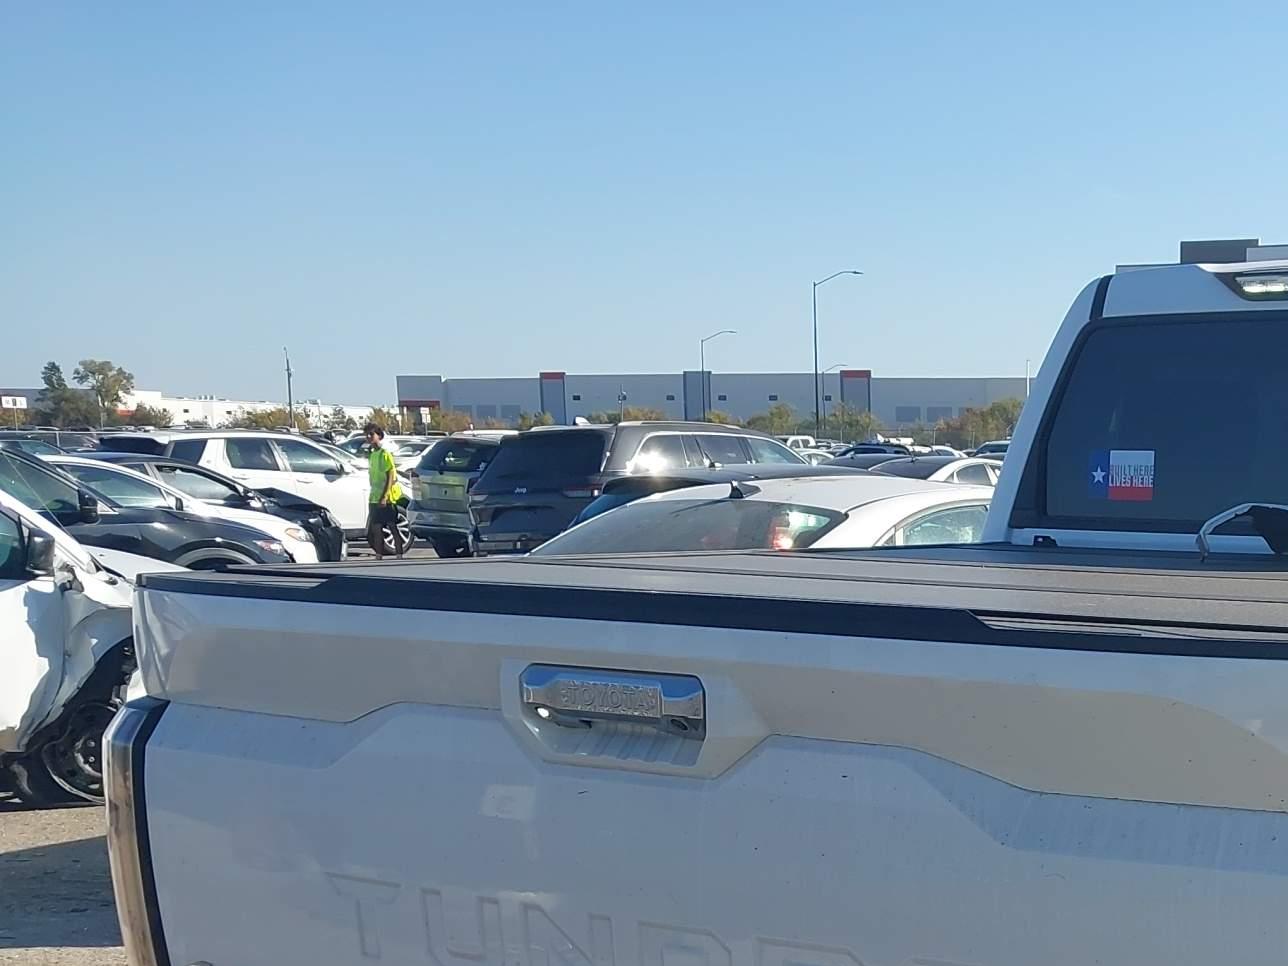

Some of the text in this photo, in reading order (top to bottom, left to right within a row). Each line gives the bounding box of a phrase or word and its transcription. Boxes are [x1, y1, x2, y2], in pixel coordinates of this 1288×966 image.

[1134, 464, 1154, 476] HERE
[1108, 475, 1154, 488] LIVES HERE
[568, 686, 650, 711] TOYOTA
